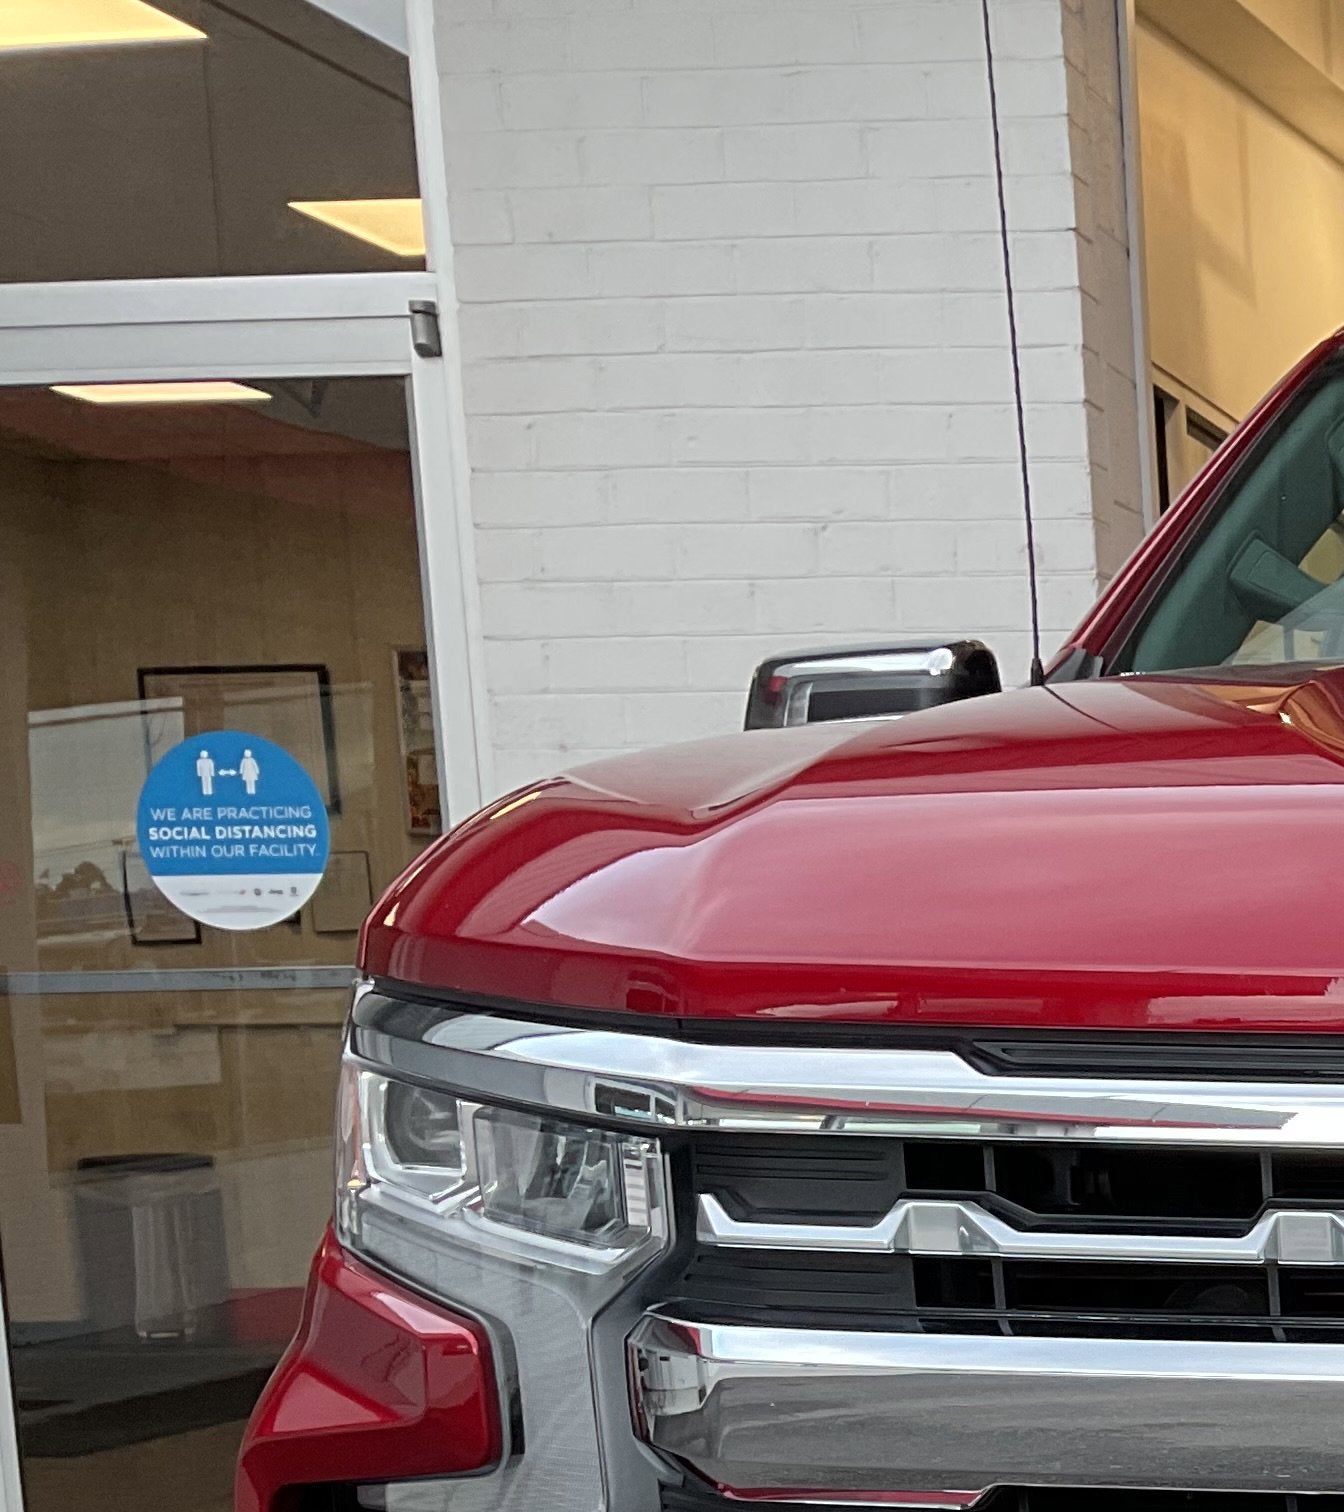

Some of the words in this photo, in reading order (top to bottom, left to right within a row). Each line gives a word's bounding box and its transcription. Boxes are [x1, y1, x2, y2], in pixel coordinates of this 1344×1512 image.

[150, 807, 177, 821] WE
[181, 806, 213, 820] ARE
[217, 805, 312, 820] PRACTICING
[148, 826, 211, 841] SOCIAL
[214, 823, 317, 840] DISTANCING
[149, 845, 207, 859] WITHIN
[211, 844, 245, 858] OUR
